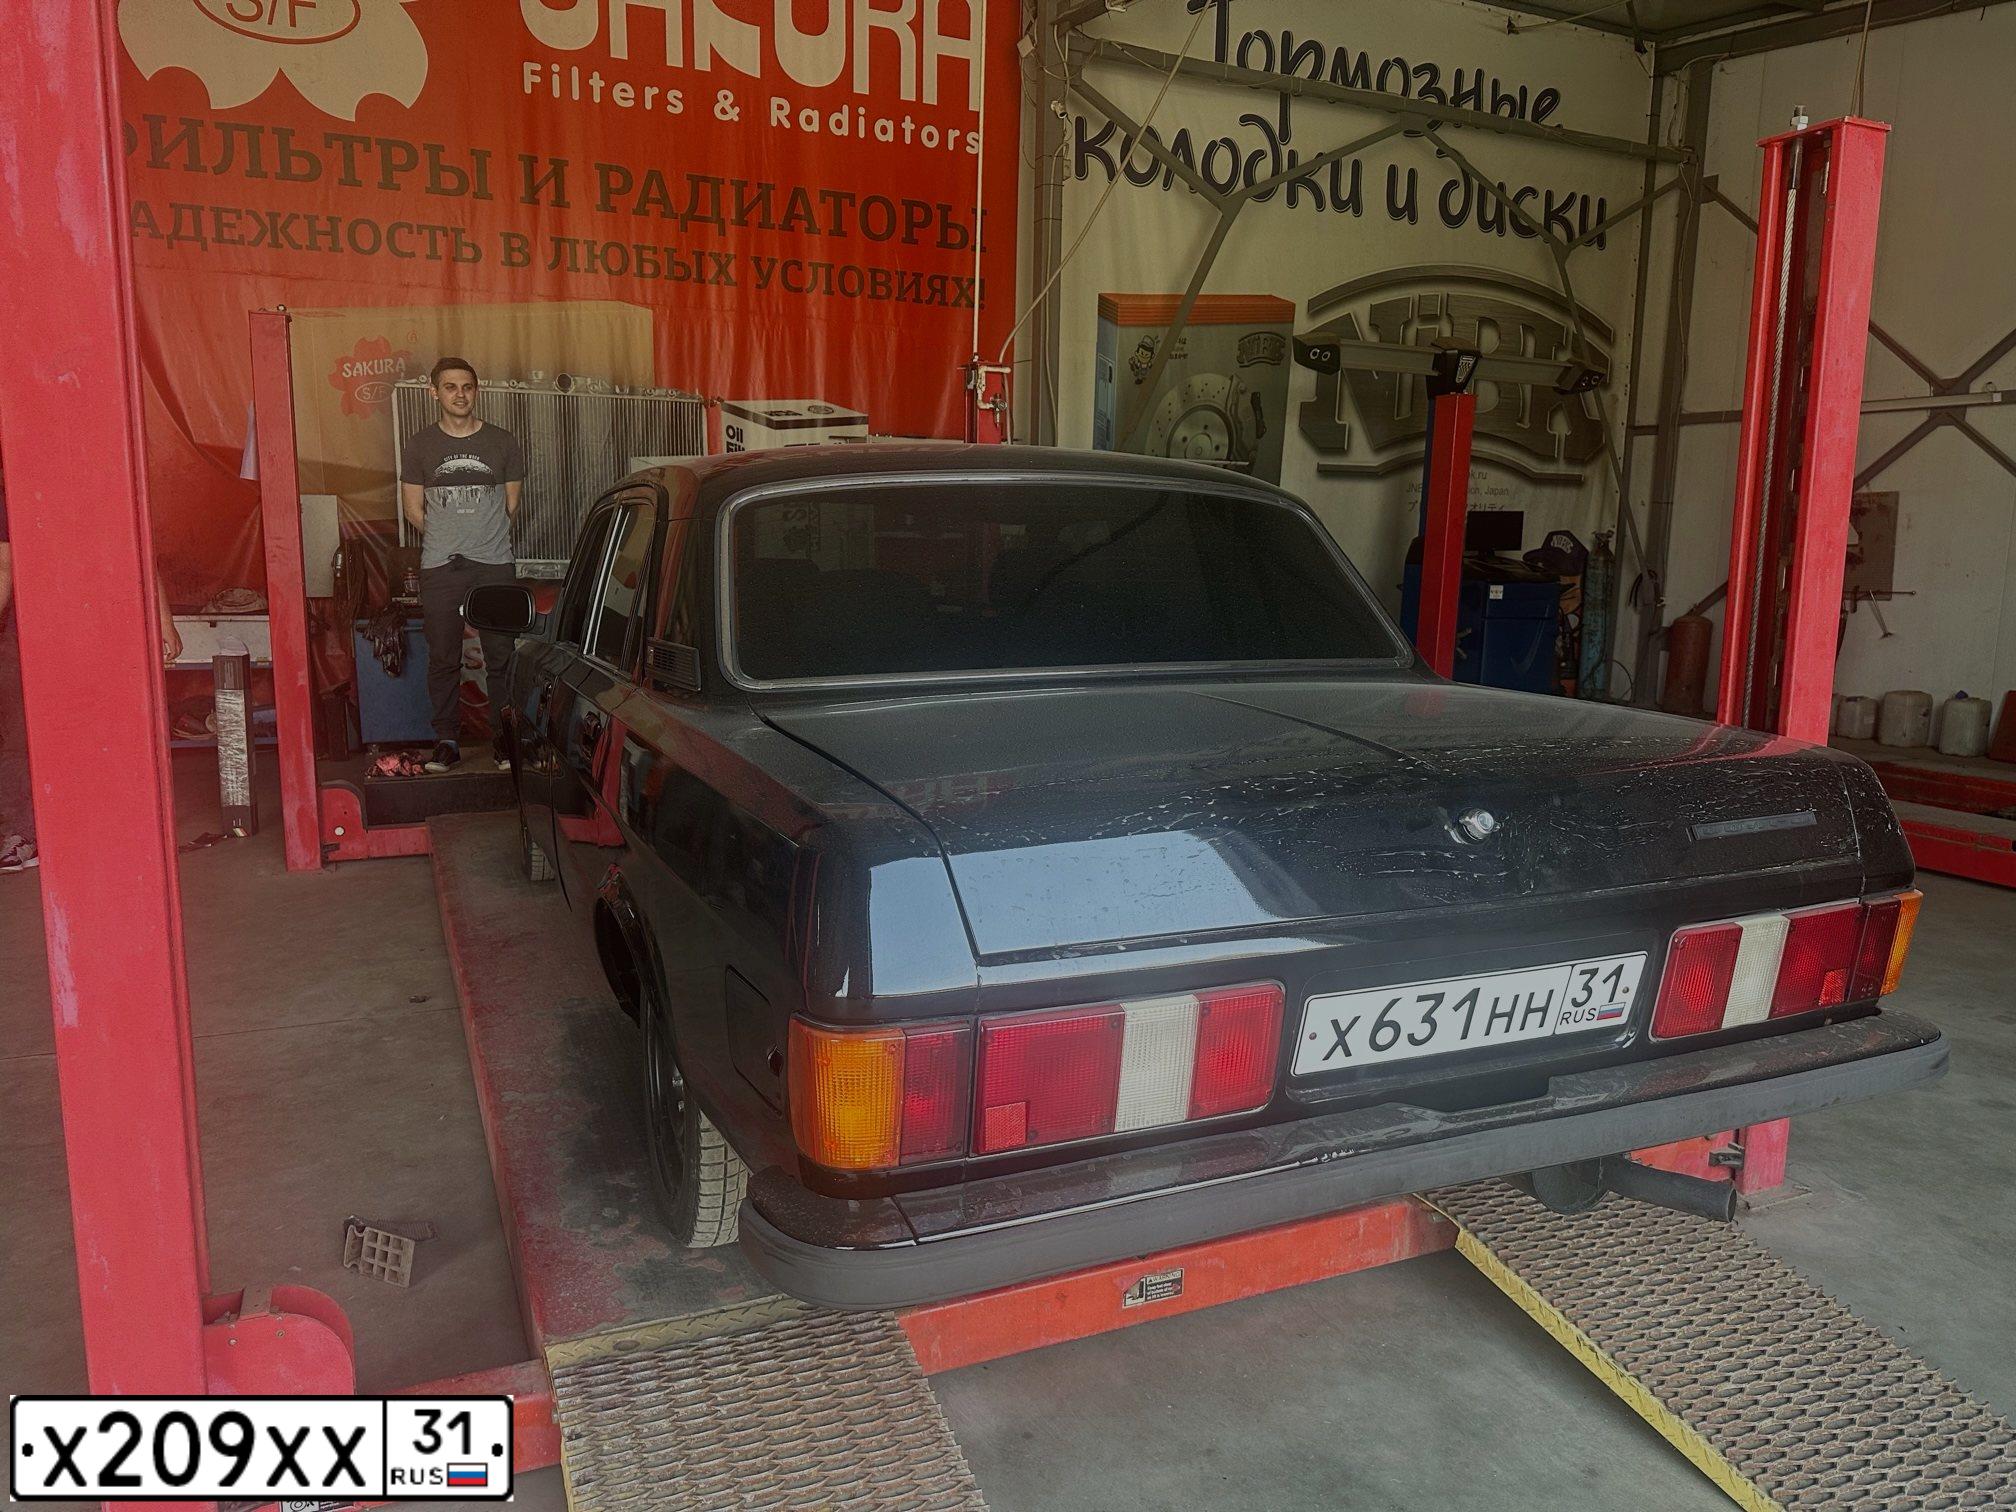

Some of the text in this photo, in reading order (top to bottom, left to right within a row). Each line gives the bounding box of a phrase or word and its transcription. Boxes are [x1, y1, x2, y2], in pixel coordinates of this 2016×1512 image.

[523, 61, 980, 155] Filters & Radiators
[518, 153, 571, 209] И
[594, 162, 987, 253] РАДИАТОРЫ
[499, 231, 531, 268] В
[547, 235, 738, 287] ЛЮБЫХ
[342, 357, 406, 378] SAKURA
[726, 424, 744, 444] Oil
[1570, 963, 1625, 1008] 31
[1559, 1007, 1597, 1026] RUS
